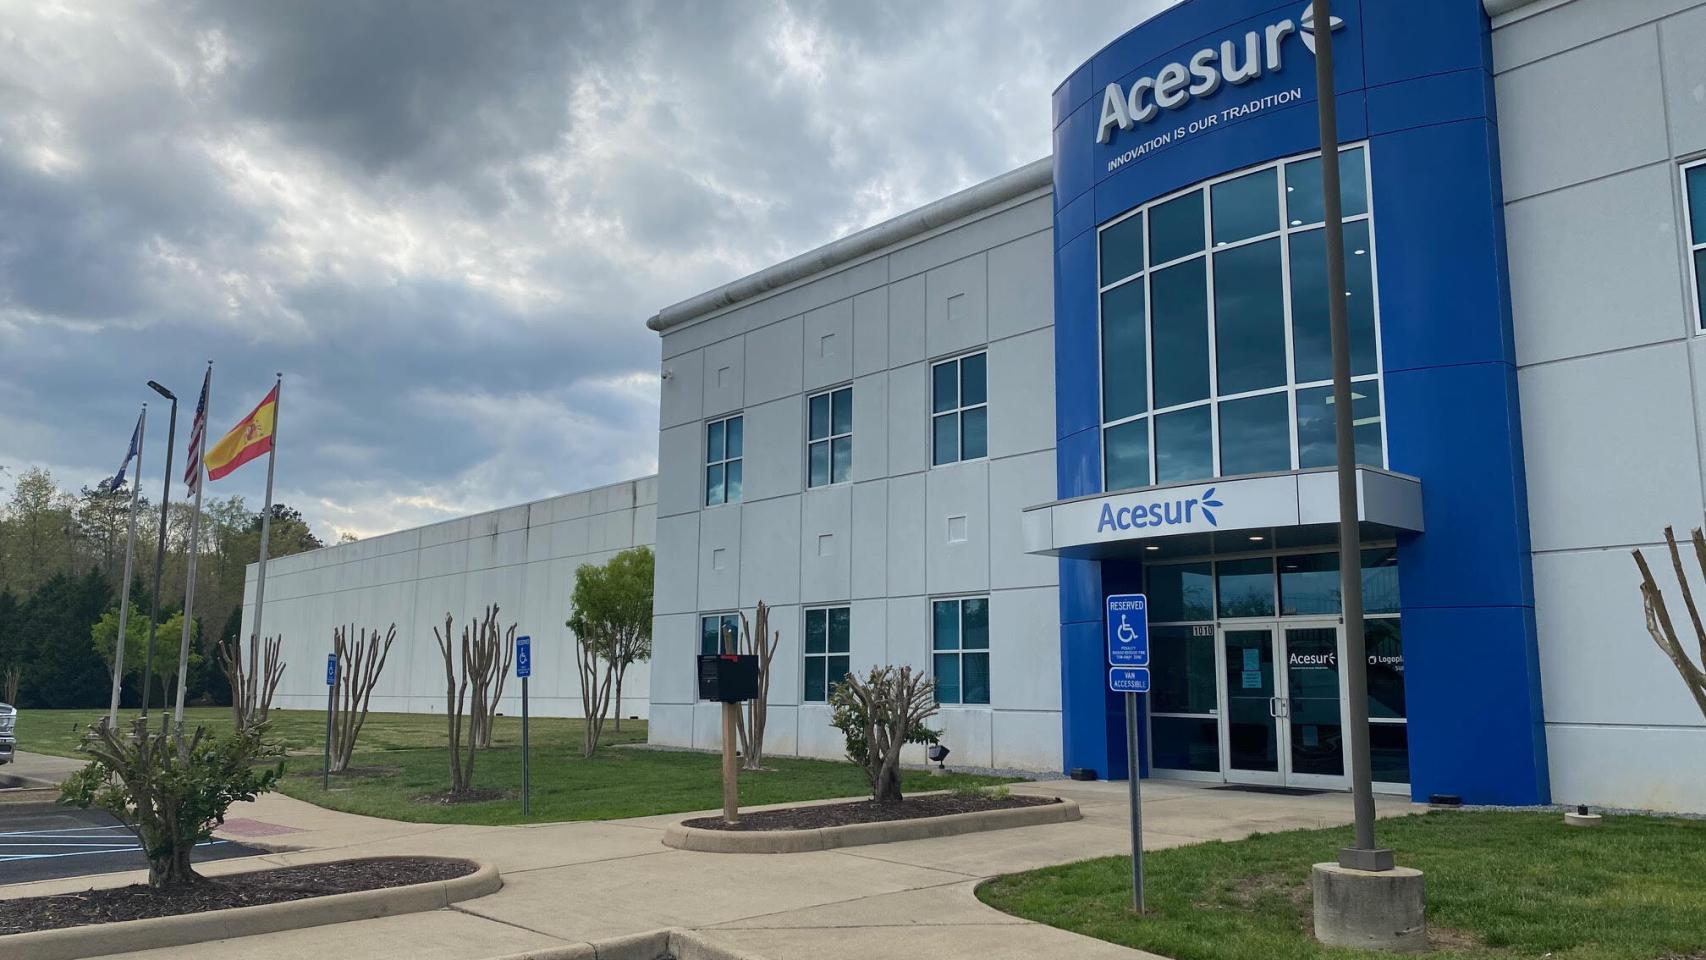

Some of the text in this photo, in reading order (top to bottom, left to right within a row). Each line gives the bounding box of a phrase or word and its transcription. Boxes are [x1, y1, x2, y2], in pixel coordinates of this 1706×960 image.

[1096, 19, 1295, 144] Acesur
[1108, 88, 1302, 172] INNOVATION IS OUR TRADITION
[1097, 499, 1197, 532] Acesur
[1110, 601, 1144, 611] RESERVED
[1194, 626, 1213, 636] 1010
[1290, 653, 1328, 664] Acesur
